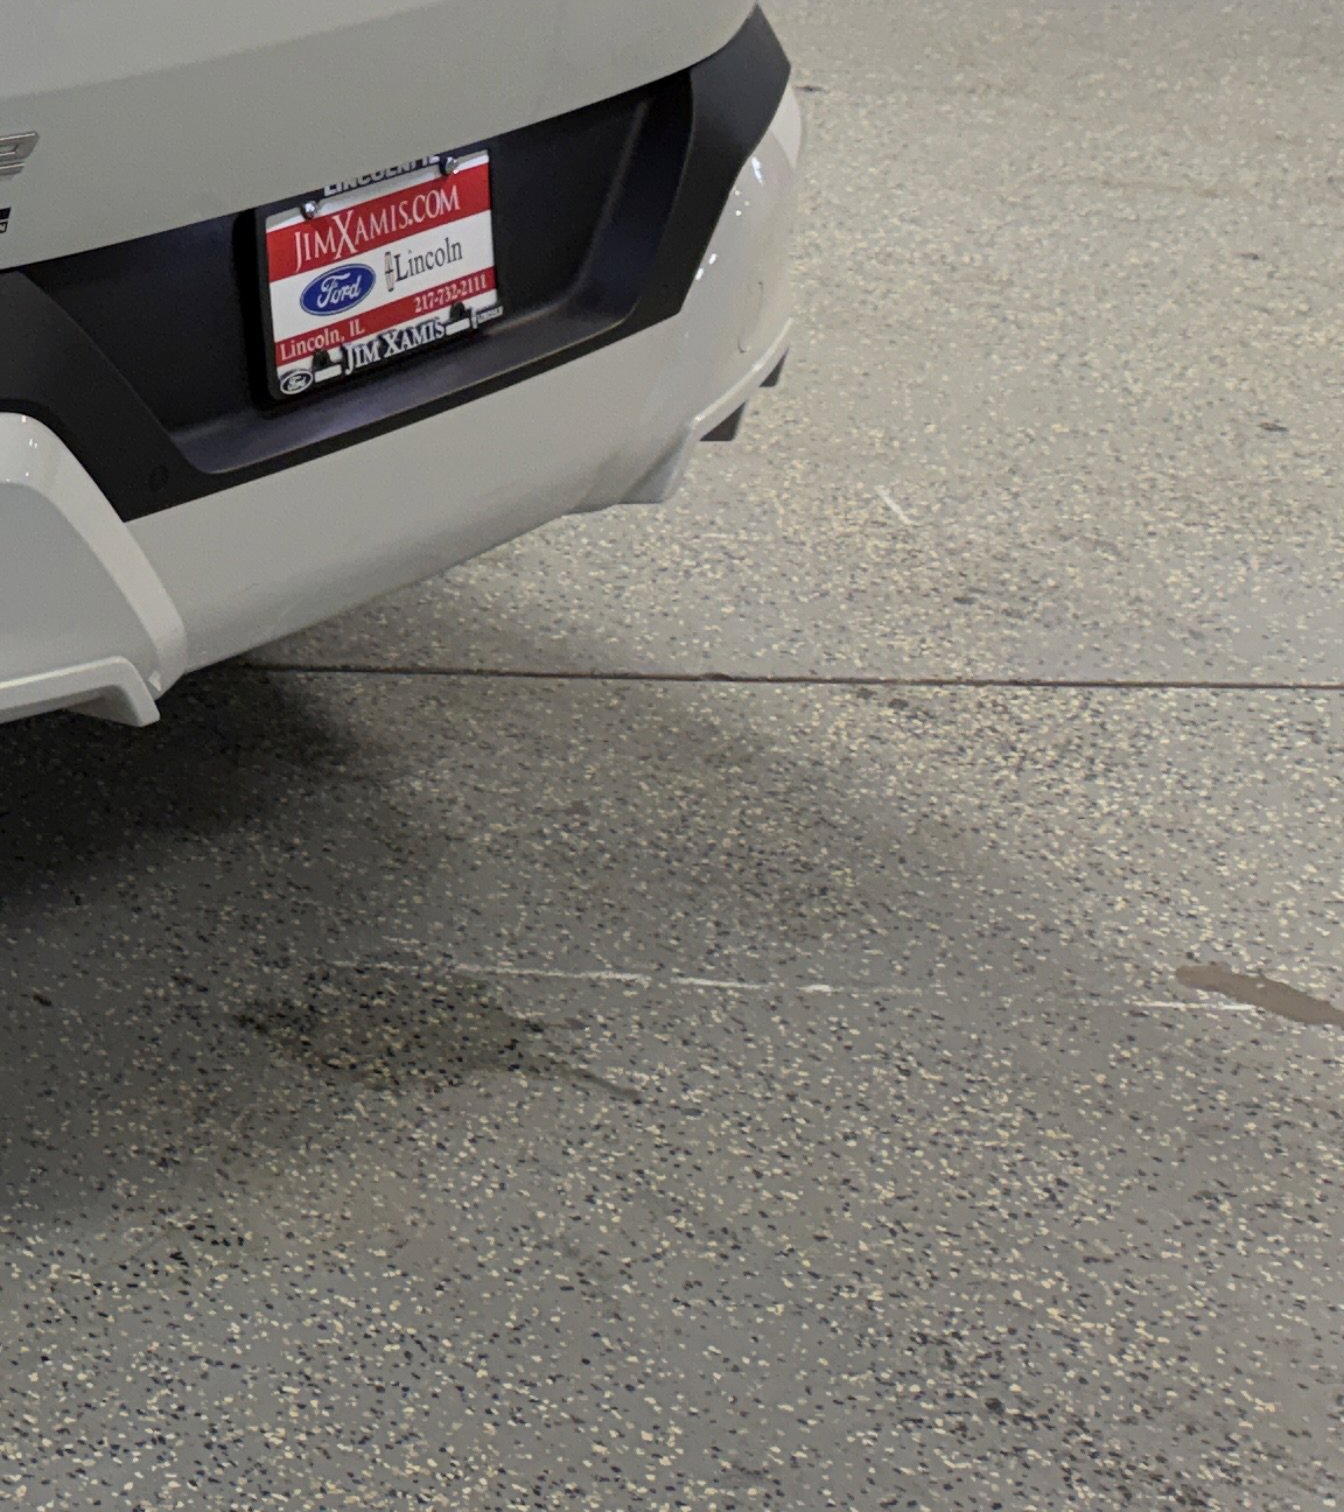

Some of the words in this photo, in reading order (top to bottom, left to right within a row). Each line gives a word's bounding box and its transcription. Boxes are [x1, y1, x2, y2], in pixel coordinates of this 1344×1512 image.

[293, 184, 461, 272] JIMXAMIS.COM
[394, 236, 463, 284] Lincoln
[316, 272, 362, 309] Ford
[413, 274, 487, 314] 217-732-2111
[279, 327, 345, 362] Lincoln,
[349, 318, 365, 337] IL
[344, 341, 381, 375] JIM
[383, 320, 446, 359] XAMIS
